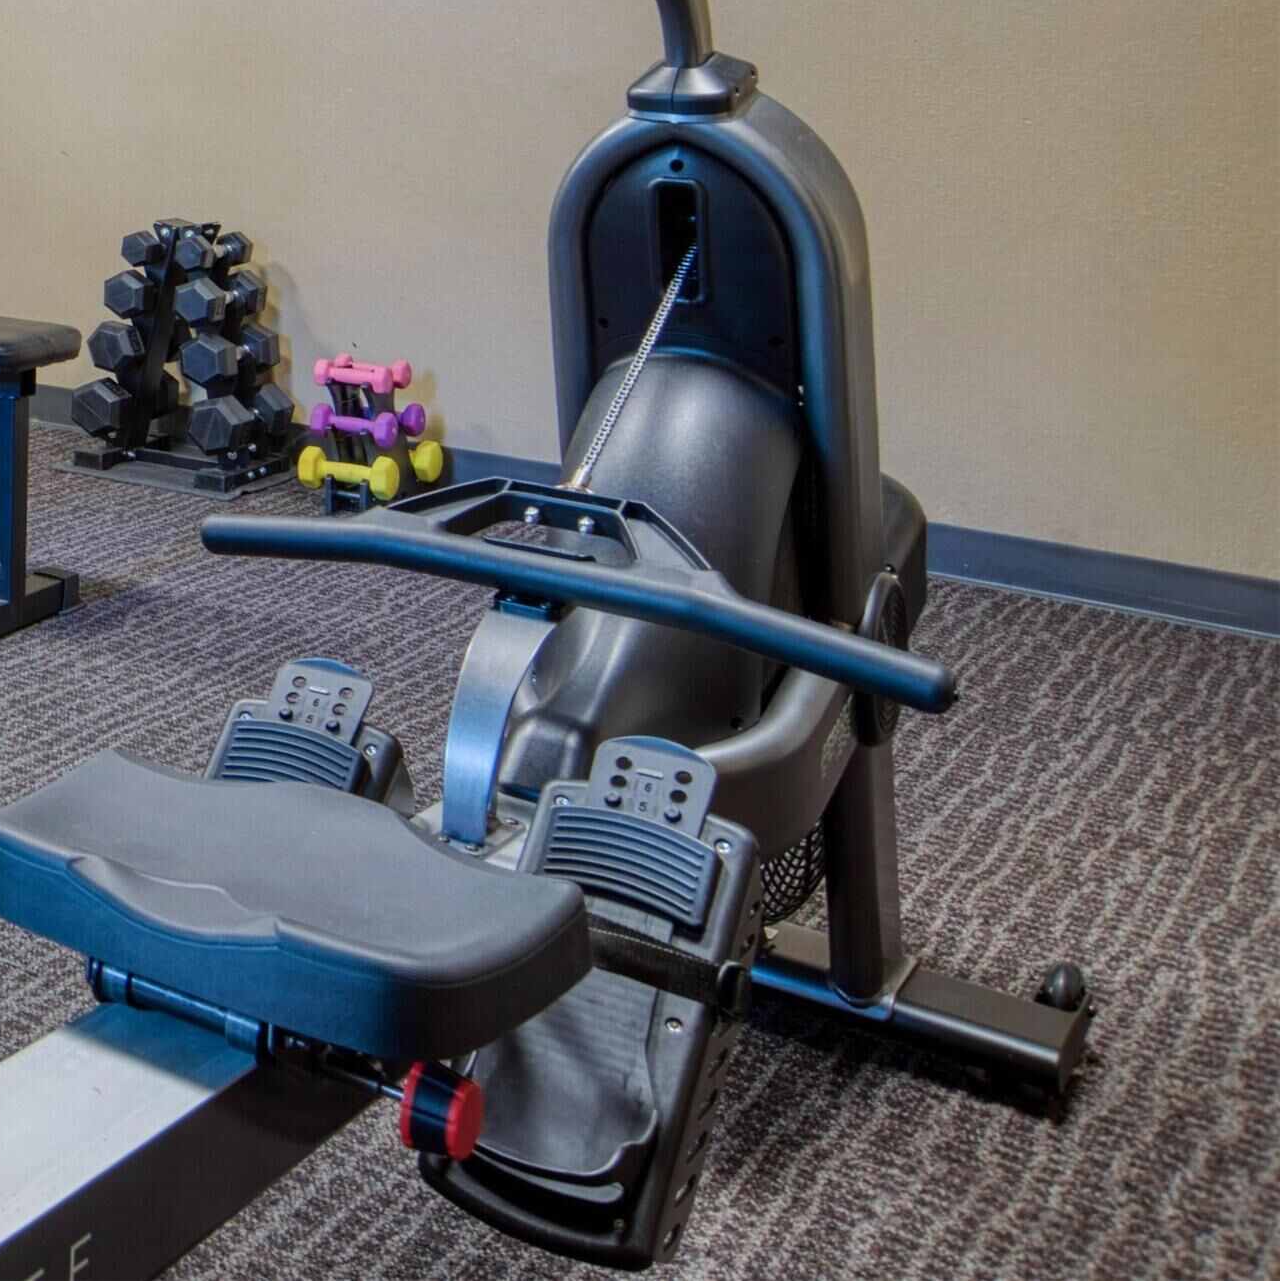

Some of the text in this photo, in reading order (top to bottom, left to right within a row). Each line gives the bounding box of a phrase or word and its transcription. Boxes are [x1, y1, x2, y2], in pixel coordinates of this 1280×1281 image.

[312, 697, 321, 708] 6
[305, 714, 315, 724] 5
[644, 782, 653, 793] 6
[637, 801, 648, 813] 5
